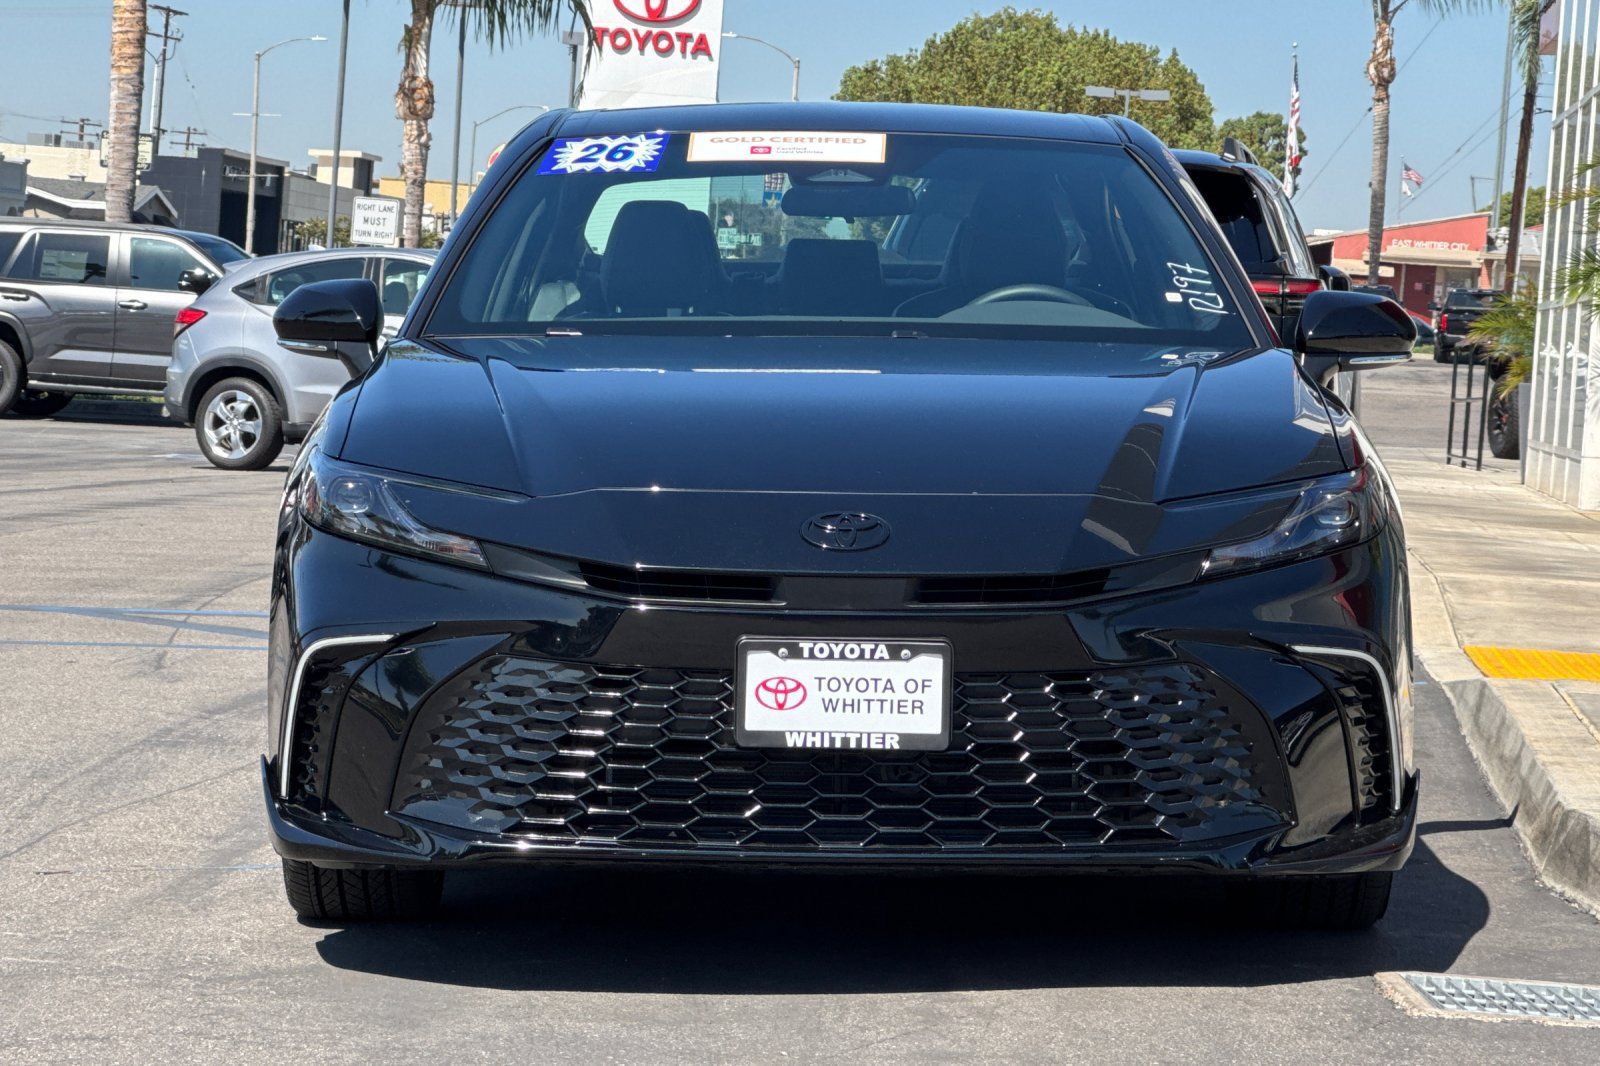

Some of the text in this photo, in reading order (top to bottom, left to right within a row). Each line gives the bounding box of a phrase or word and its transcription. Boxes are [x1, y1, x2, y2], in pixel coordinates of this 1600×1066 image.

[593, 27, 712, 58] TOYOTA
[769, 136, 867, 145] CERTIFIED
[571, 143, 639, 164] 26
[356, 203, 395, 213] RIGHT LANE
[362, 216, 387, 227] MUST
[354, 229, 393, 240] TURN RIGHT
[1391, 238, 1413, 248] EAST
[1413, 240, 1450, 250] WHITTIER
[798, 642, 890, 660] TOYOTA
[814, 676, 933, 694] TOYOTA OF
[821, 697, 924, 715] WHITTIER
[785, 731, 900, 750] WHITTIER
